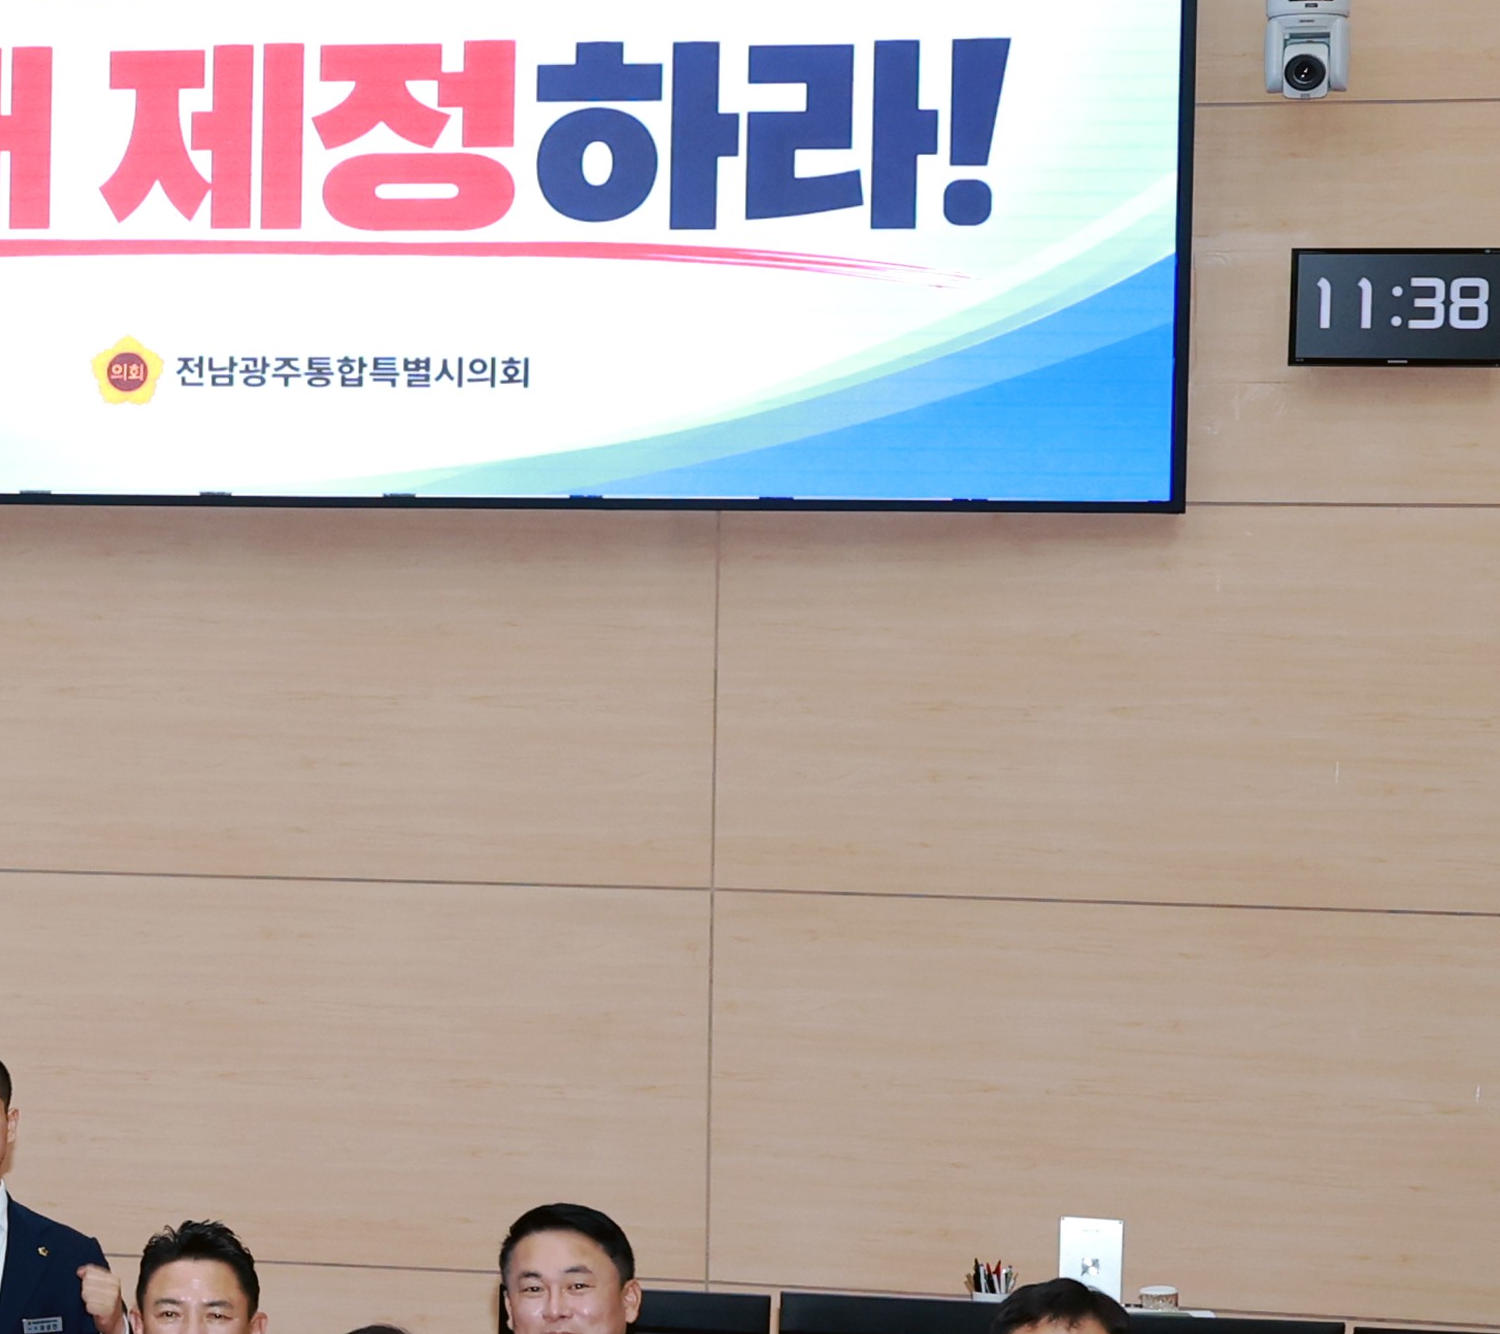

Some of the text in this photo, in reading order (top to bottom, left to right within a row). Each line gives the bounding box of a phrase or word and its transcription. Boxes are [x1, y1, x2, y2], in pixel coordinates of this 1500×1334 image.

[100, 38, 1011, 230] 제정하라!
[1317, 277, 1490, 329] 11:38
[110, 362, 145, 382] 의회
[176, 356, 530, 388] 전남광주통합특별시의회
